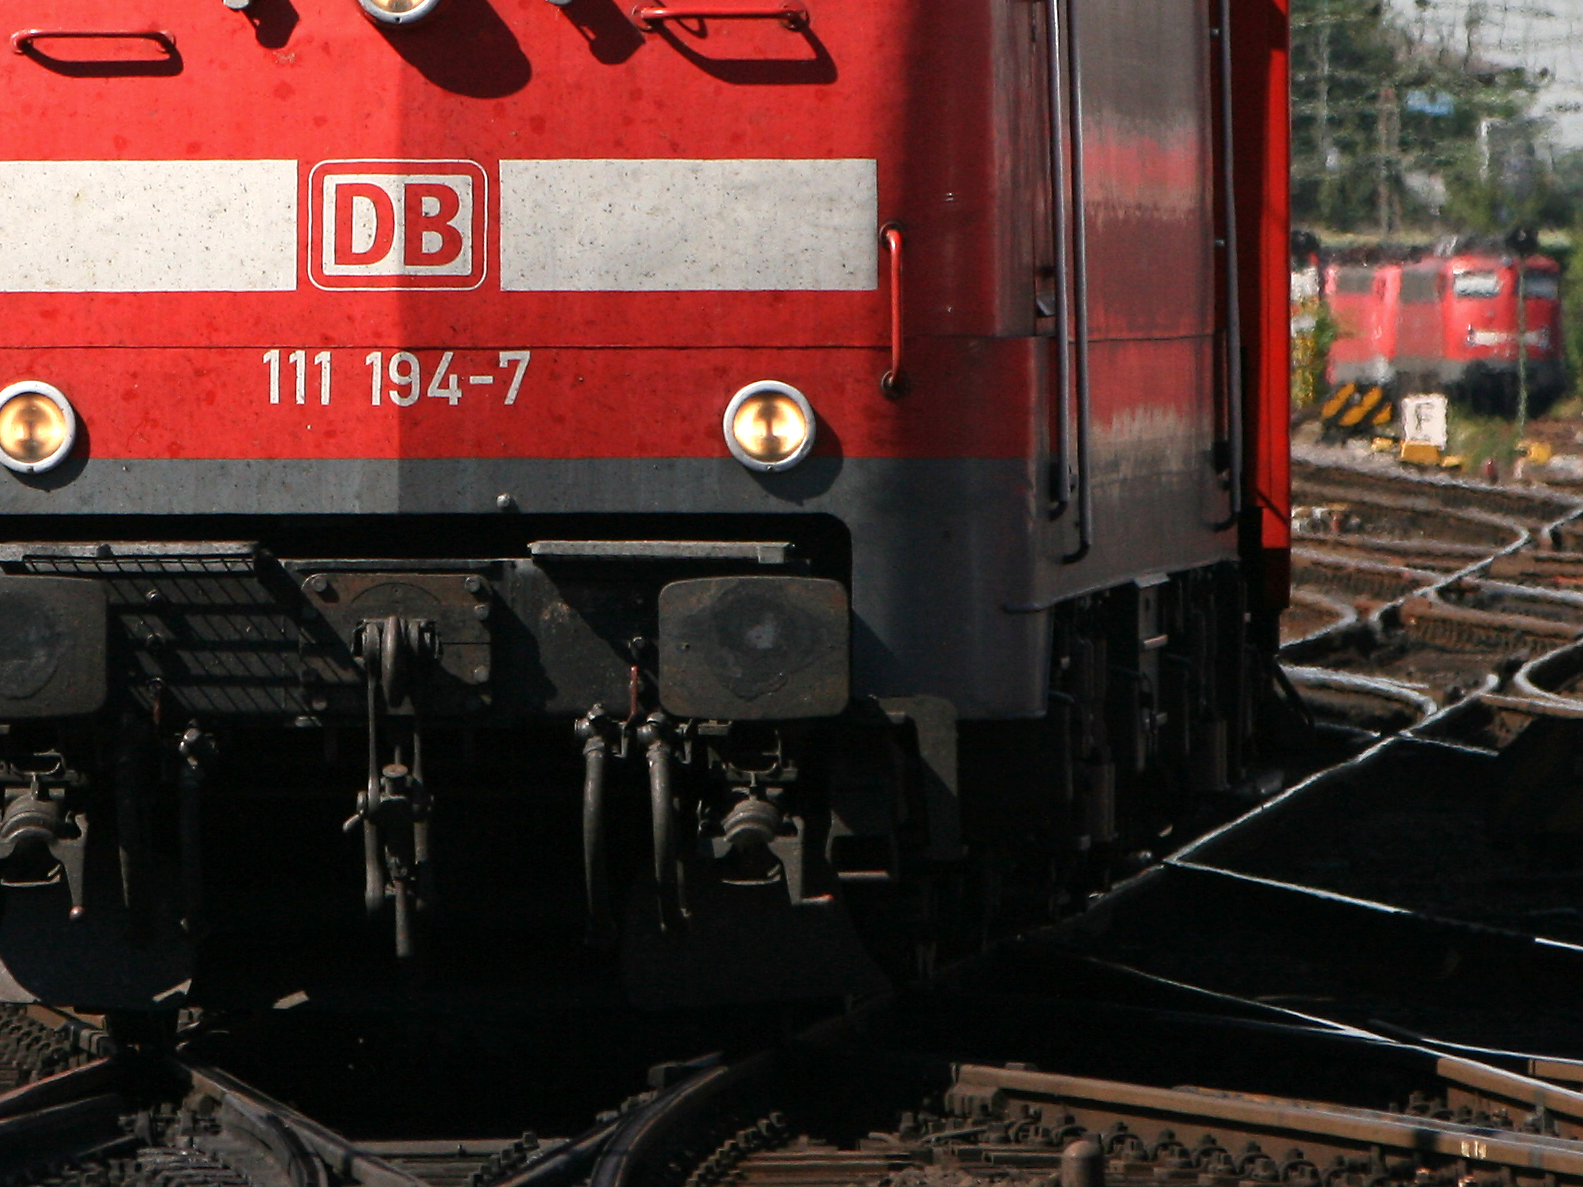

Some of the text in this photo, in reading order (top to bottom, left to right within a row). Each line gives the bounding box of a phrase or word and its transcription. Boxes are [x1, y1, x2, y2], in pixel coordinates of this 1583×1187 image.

[334, 183, 463, 267] DB
[263, 349, 531, 407] 111 194-7
